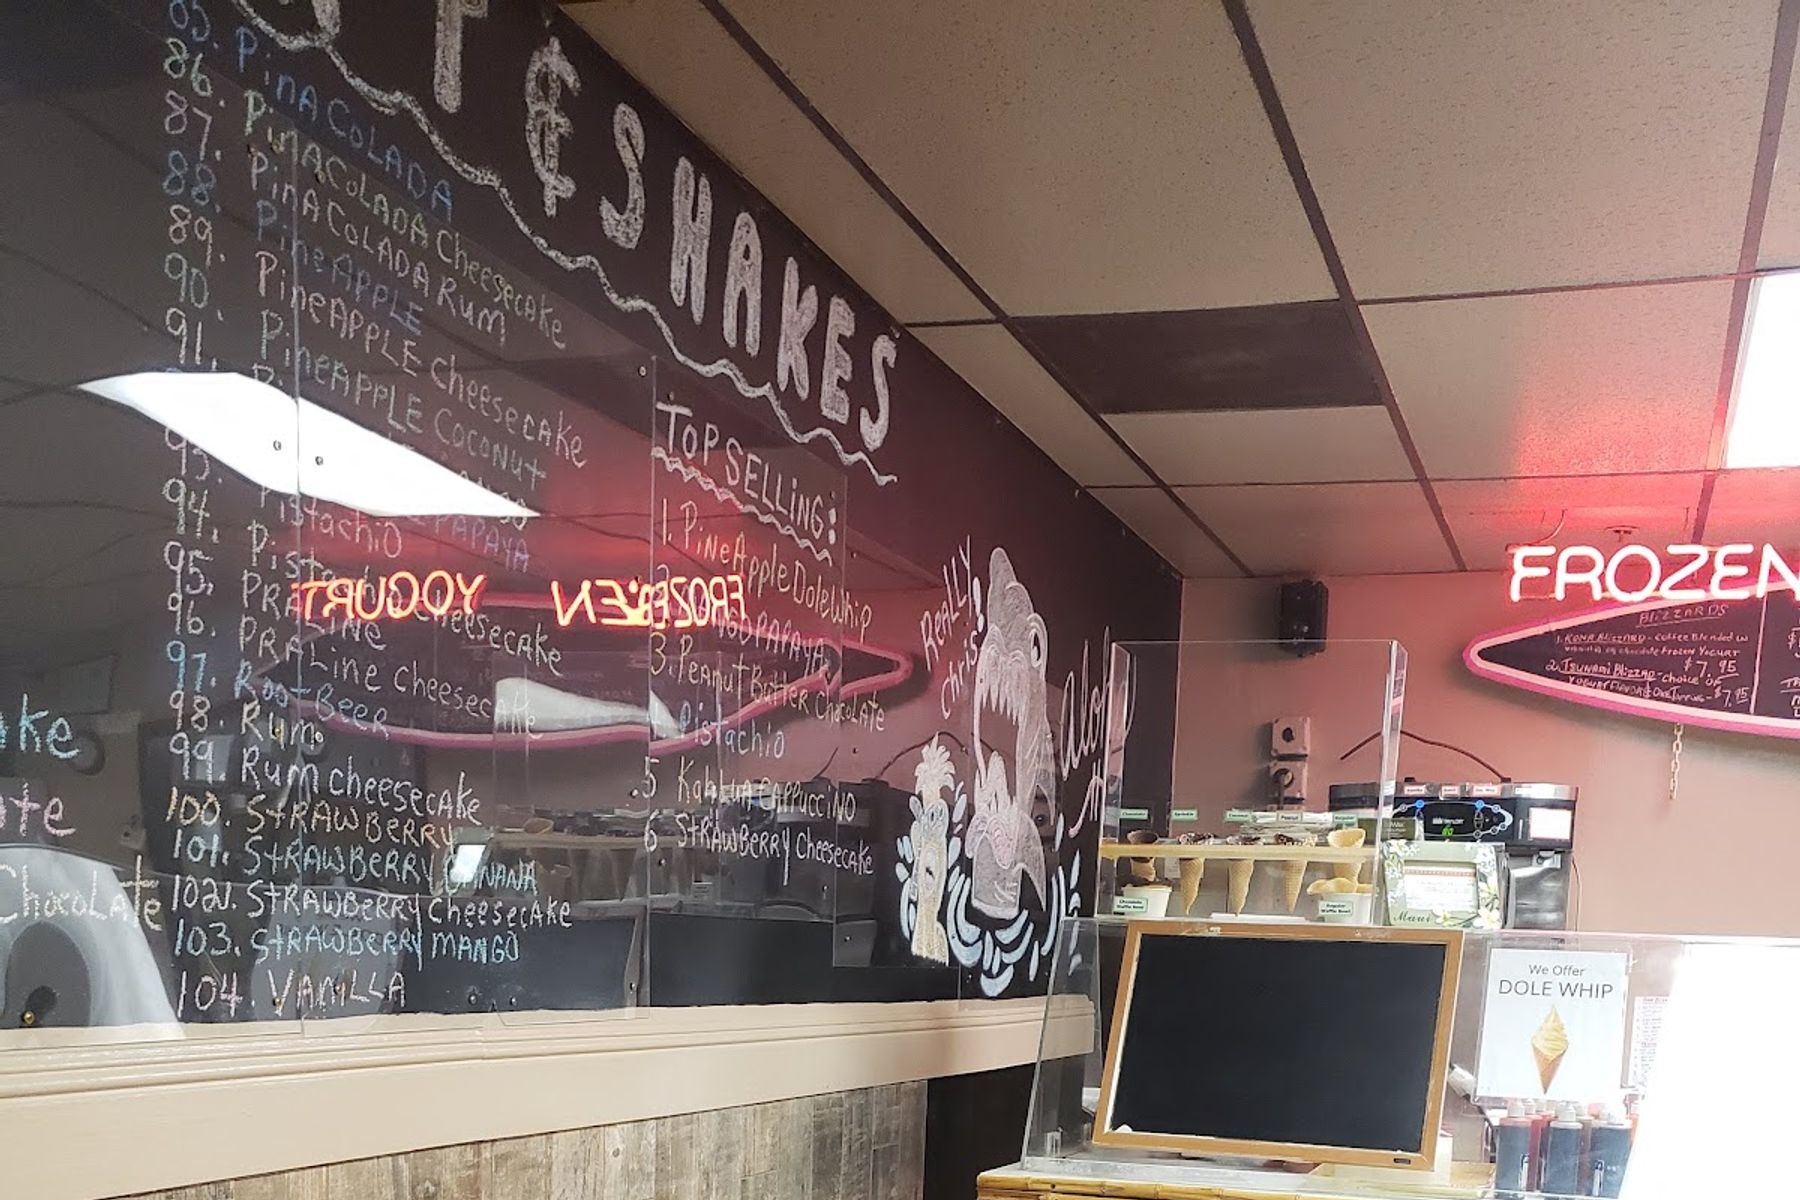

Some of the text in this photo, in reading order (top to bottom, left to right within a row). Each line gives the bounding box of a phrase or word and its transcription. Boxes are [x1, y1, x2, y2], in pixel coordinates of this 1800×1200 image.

[600, 102, 897, 452] SHAKES
[443, 852, 538, 897] BNANA
[1528, 963, 1585, 977] We Offer
[1498, 978, 1614, 999] DOLE WHIP
